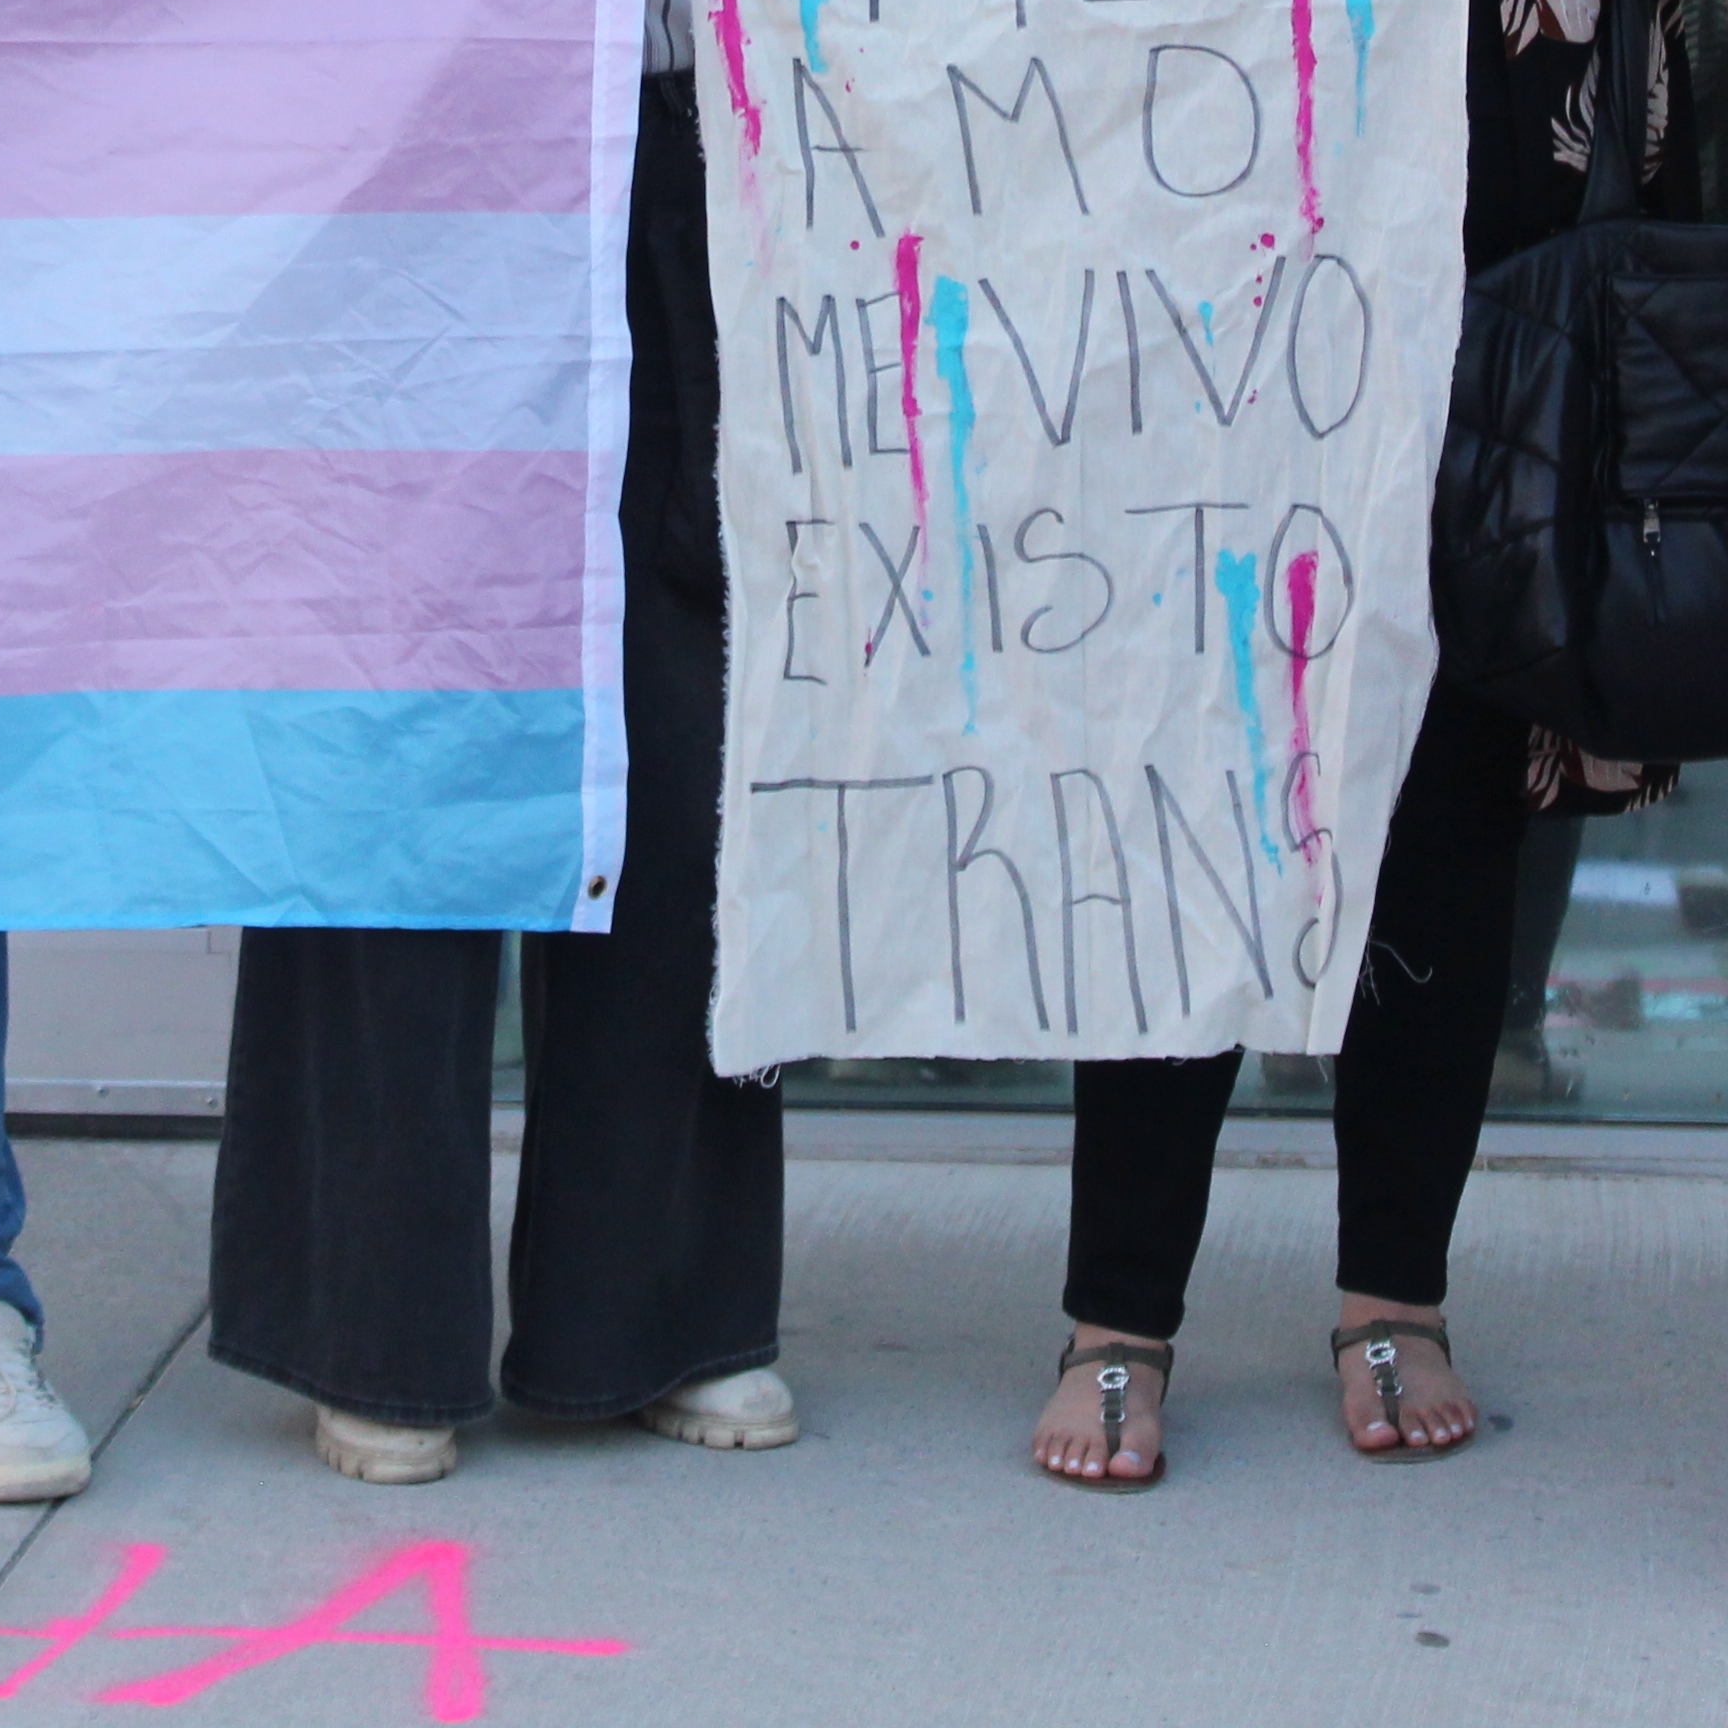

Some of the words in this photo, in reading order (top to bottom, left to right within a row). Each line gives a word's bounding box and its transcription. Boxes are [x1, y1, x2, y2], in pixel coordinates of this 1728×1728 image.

[792, 44, 1262, 238] AMO
[775, 290, 914, 474] ME
[978, 254, 1373, 448] VIVO
[782, 502, 1356, 687] EXISTO
[749, 750, 1344, 1036] TRANS
